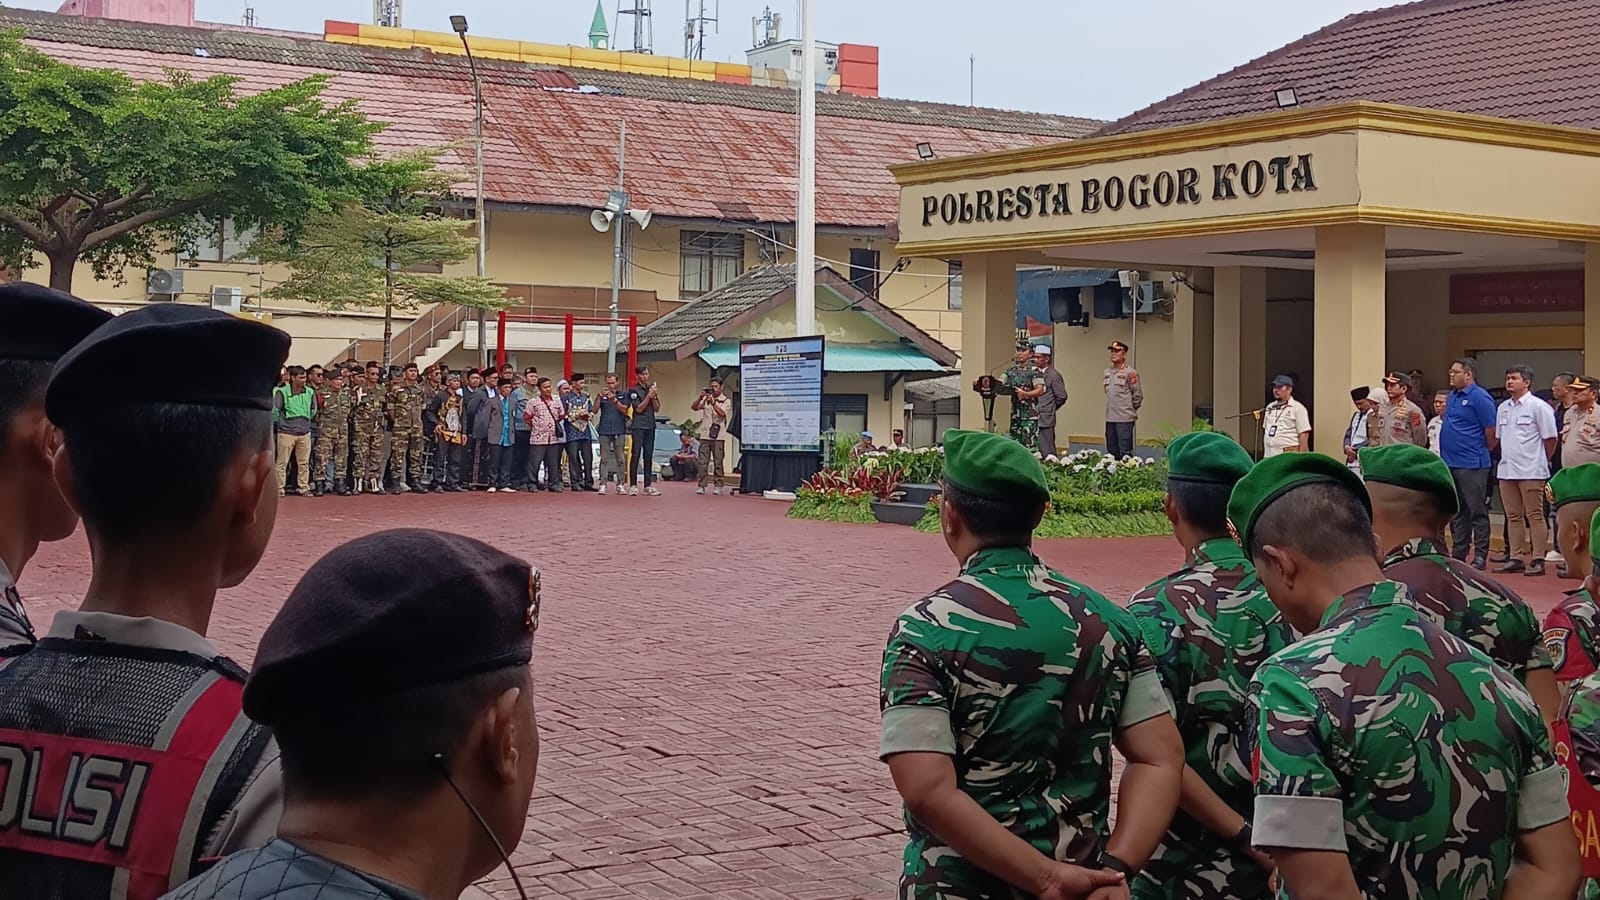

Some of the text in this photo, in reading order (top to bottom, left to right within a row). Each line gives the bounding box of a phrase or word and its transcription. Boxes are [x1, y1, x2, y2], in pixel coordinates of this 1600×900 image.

[922, 153, 1318, 227] POLRESTA BOGOR KOTA
